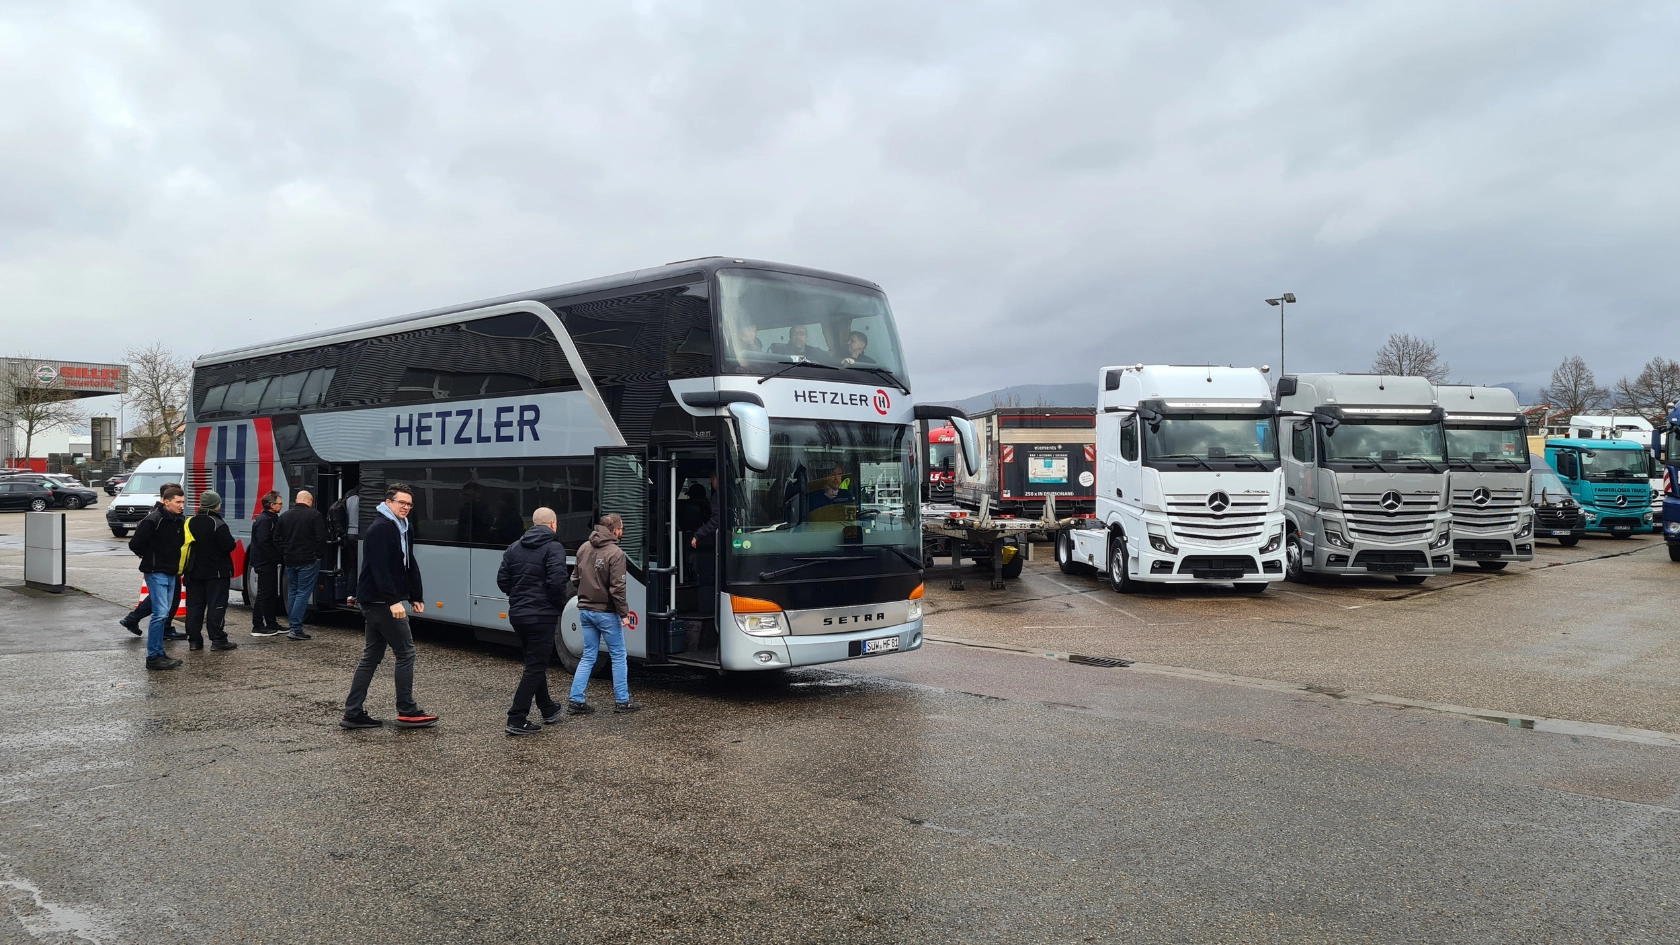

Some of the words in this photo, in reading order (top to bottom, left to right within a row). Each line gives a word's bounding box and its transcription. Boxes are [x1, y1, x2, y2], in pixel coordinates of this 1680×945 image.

[60, 366, 121, 379] GILLET
[794, 389, 869, 407] HETZLER
[394, 404, 541, 447] HETZLER
[823, 612, 885, 626] SETRA
